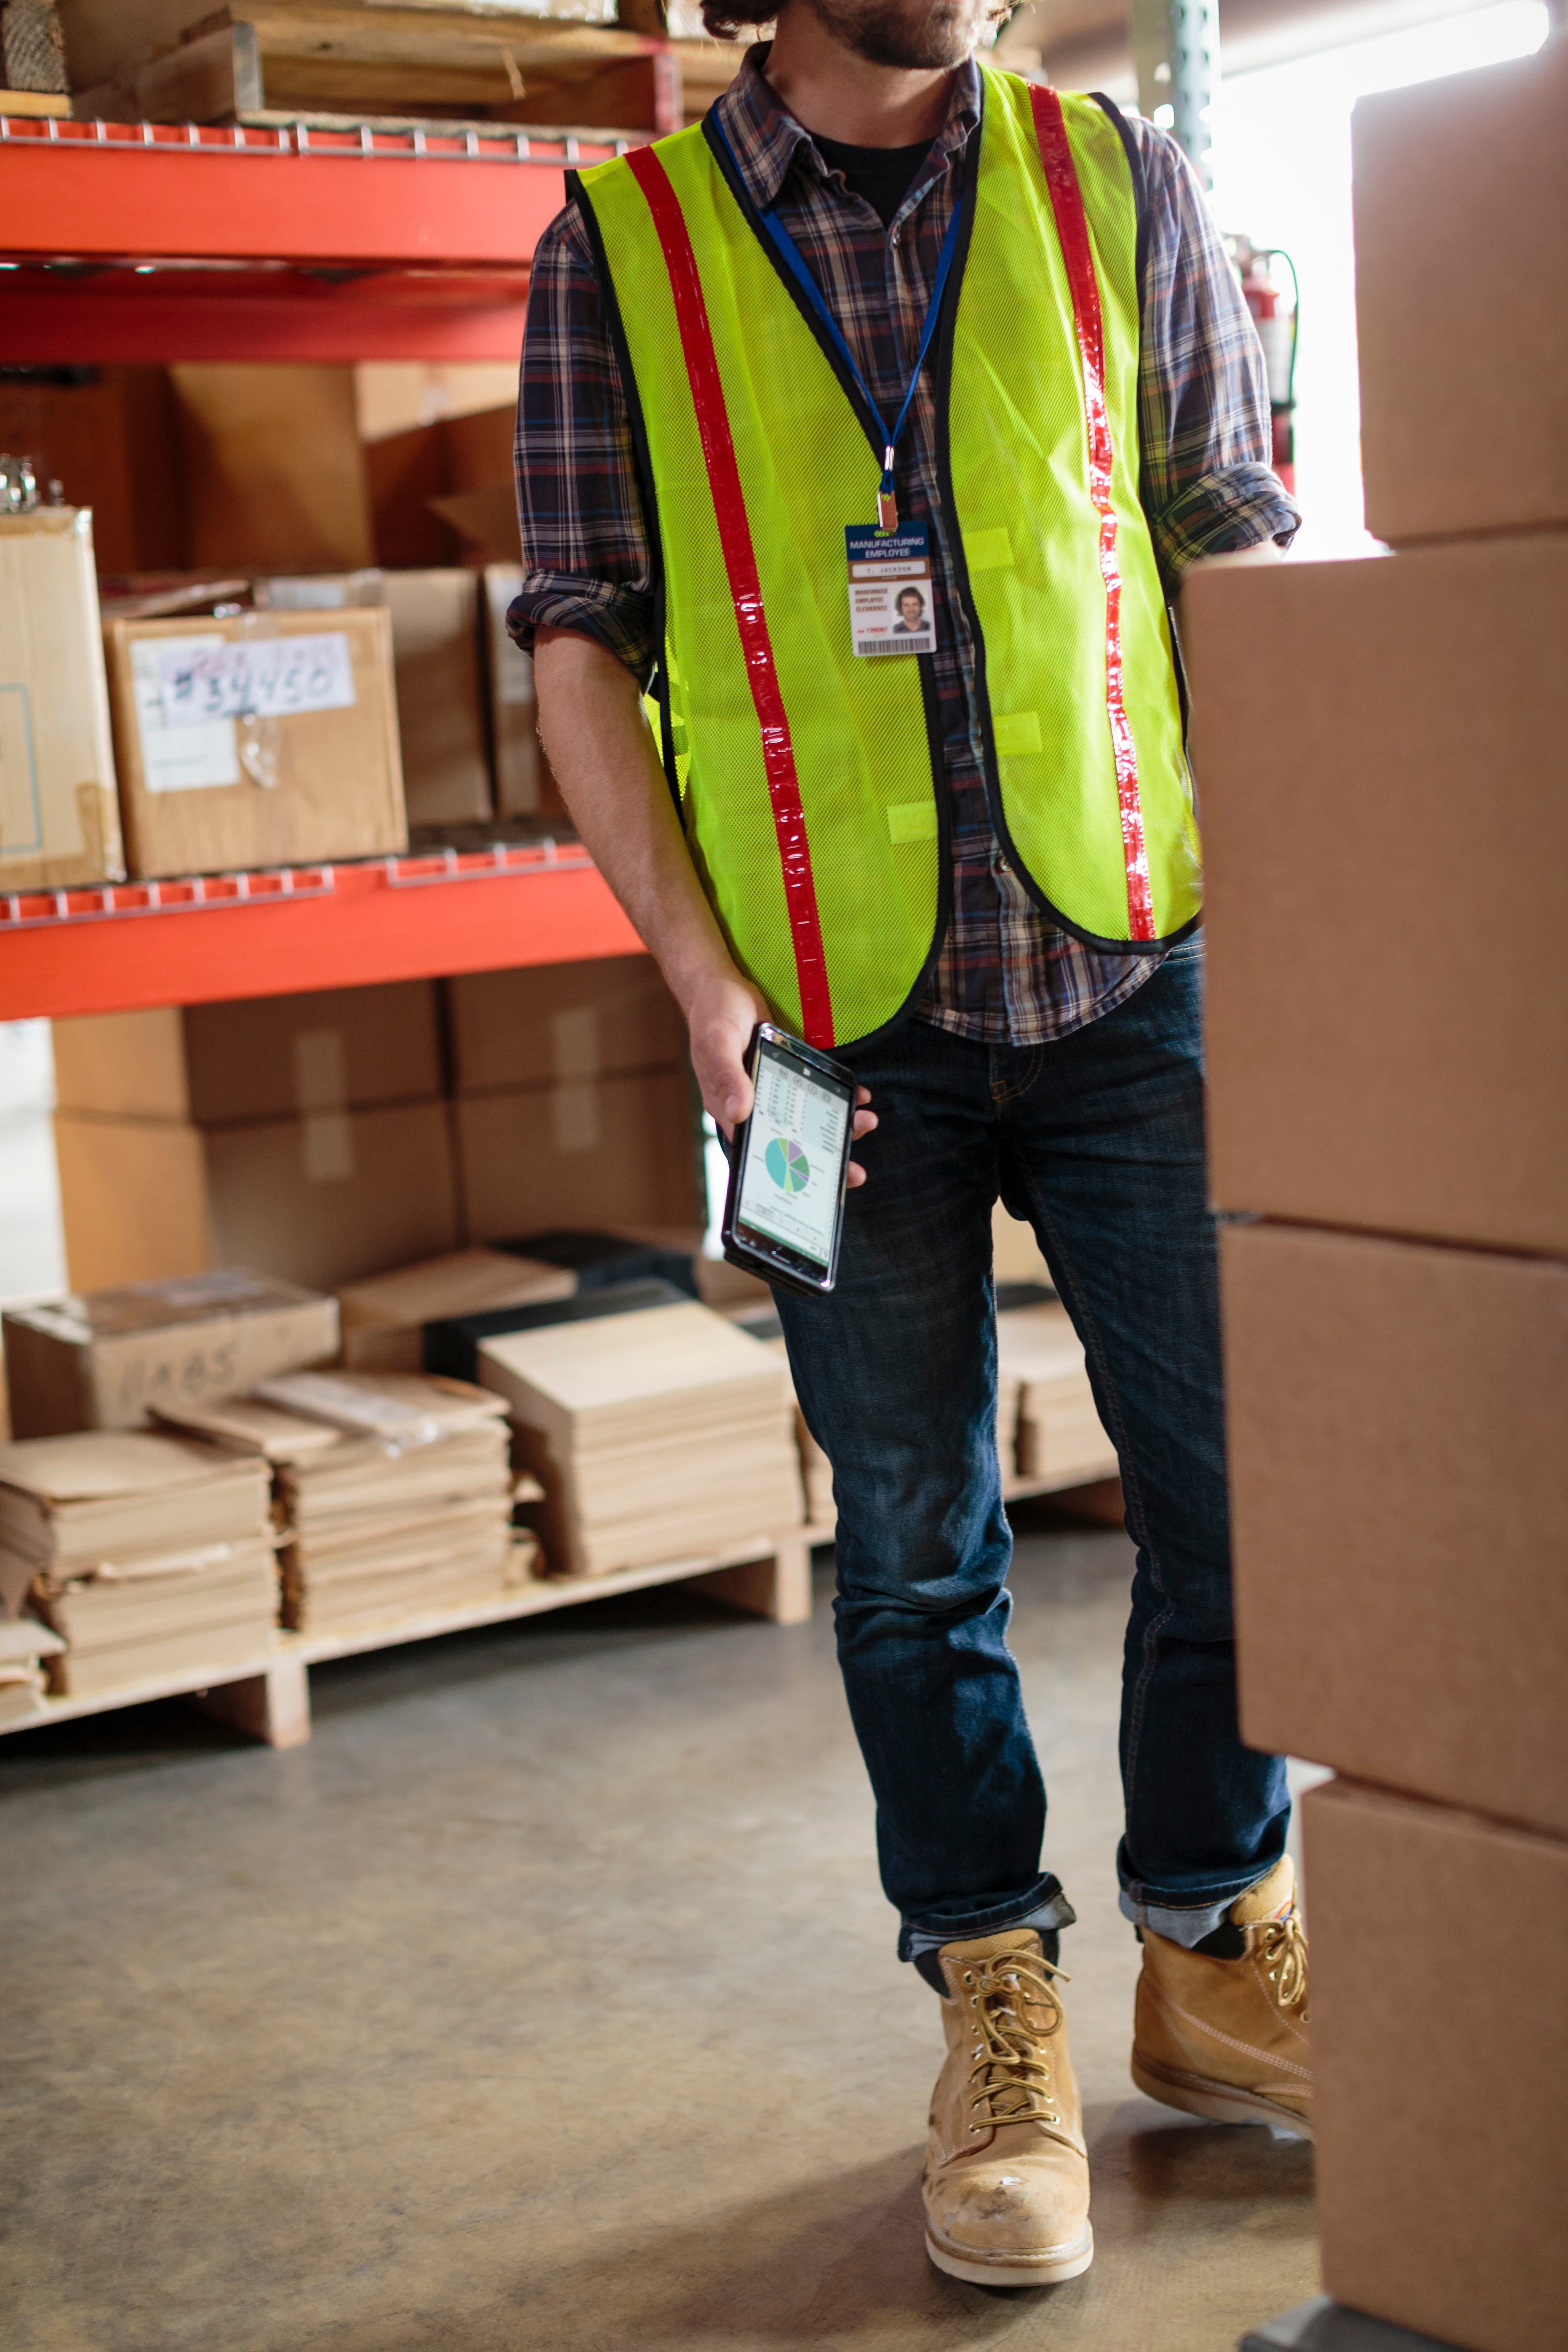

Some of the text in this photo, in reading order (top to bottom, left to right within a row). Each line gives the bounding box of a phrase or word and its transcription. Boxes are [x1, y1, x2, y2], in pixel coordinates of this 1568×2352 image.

[850, 538, 924, 549] MANUFACTURING
[865, 548, 910, 559] EMPLOYEE
[881, 566, 911, 574] JACKSON
